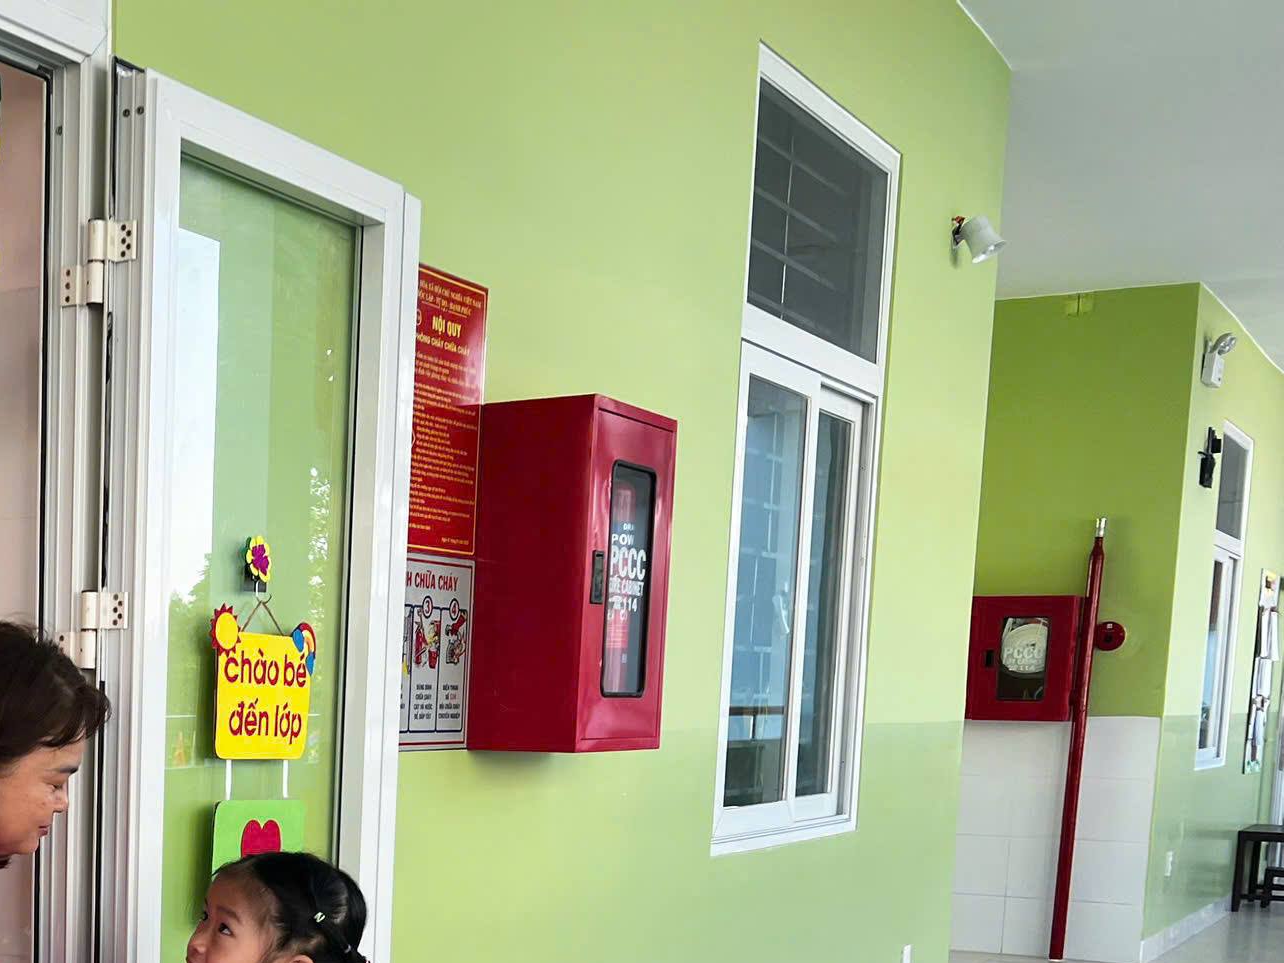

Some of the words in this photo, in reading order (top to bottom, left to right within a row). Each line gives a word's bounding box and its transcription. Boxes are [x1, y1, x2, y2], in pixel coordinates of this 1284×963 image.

[432, 315, 445, 335] NỘI
[447, 320, 462, 338] QUY
[610, 545, 647, 580] PCCC
[414, 570, 436, 590] CHỮA
[438, 572, 459, 592] CHÁY
[424, 600, 431, 614] 3
[224, 648, 280, 686] chào
[283, 653, 307, 688] bé
[228, 698, 269, 737] đến
[274, 702, 302, 745] lớp
